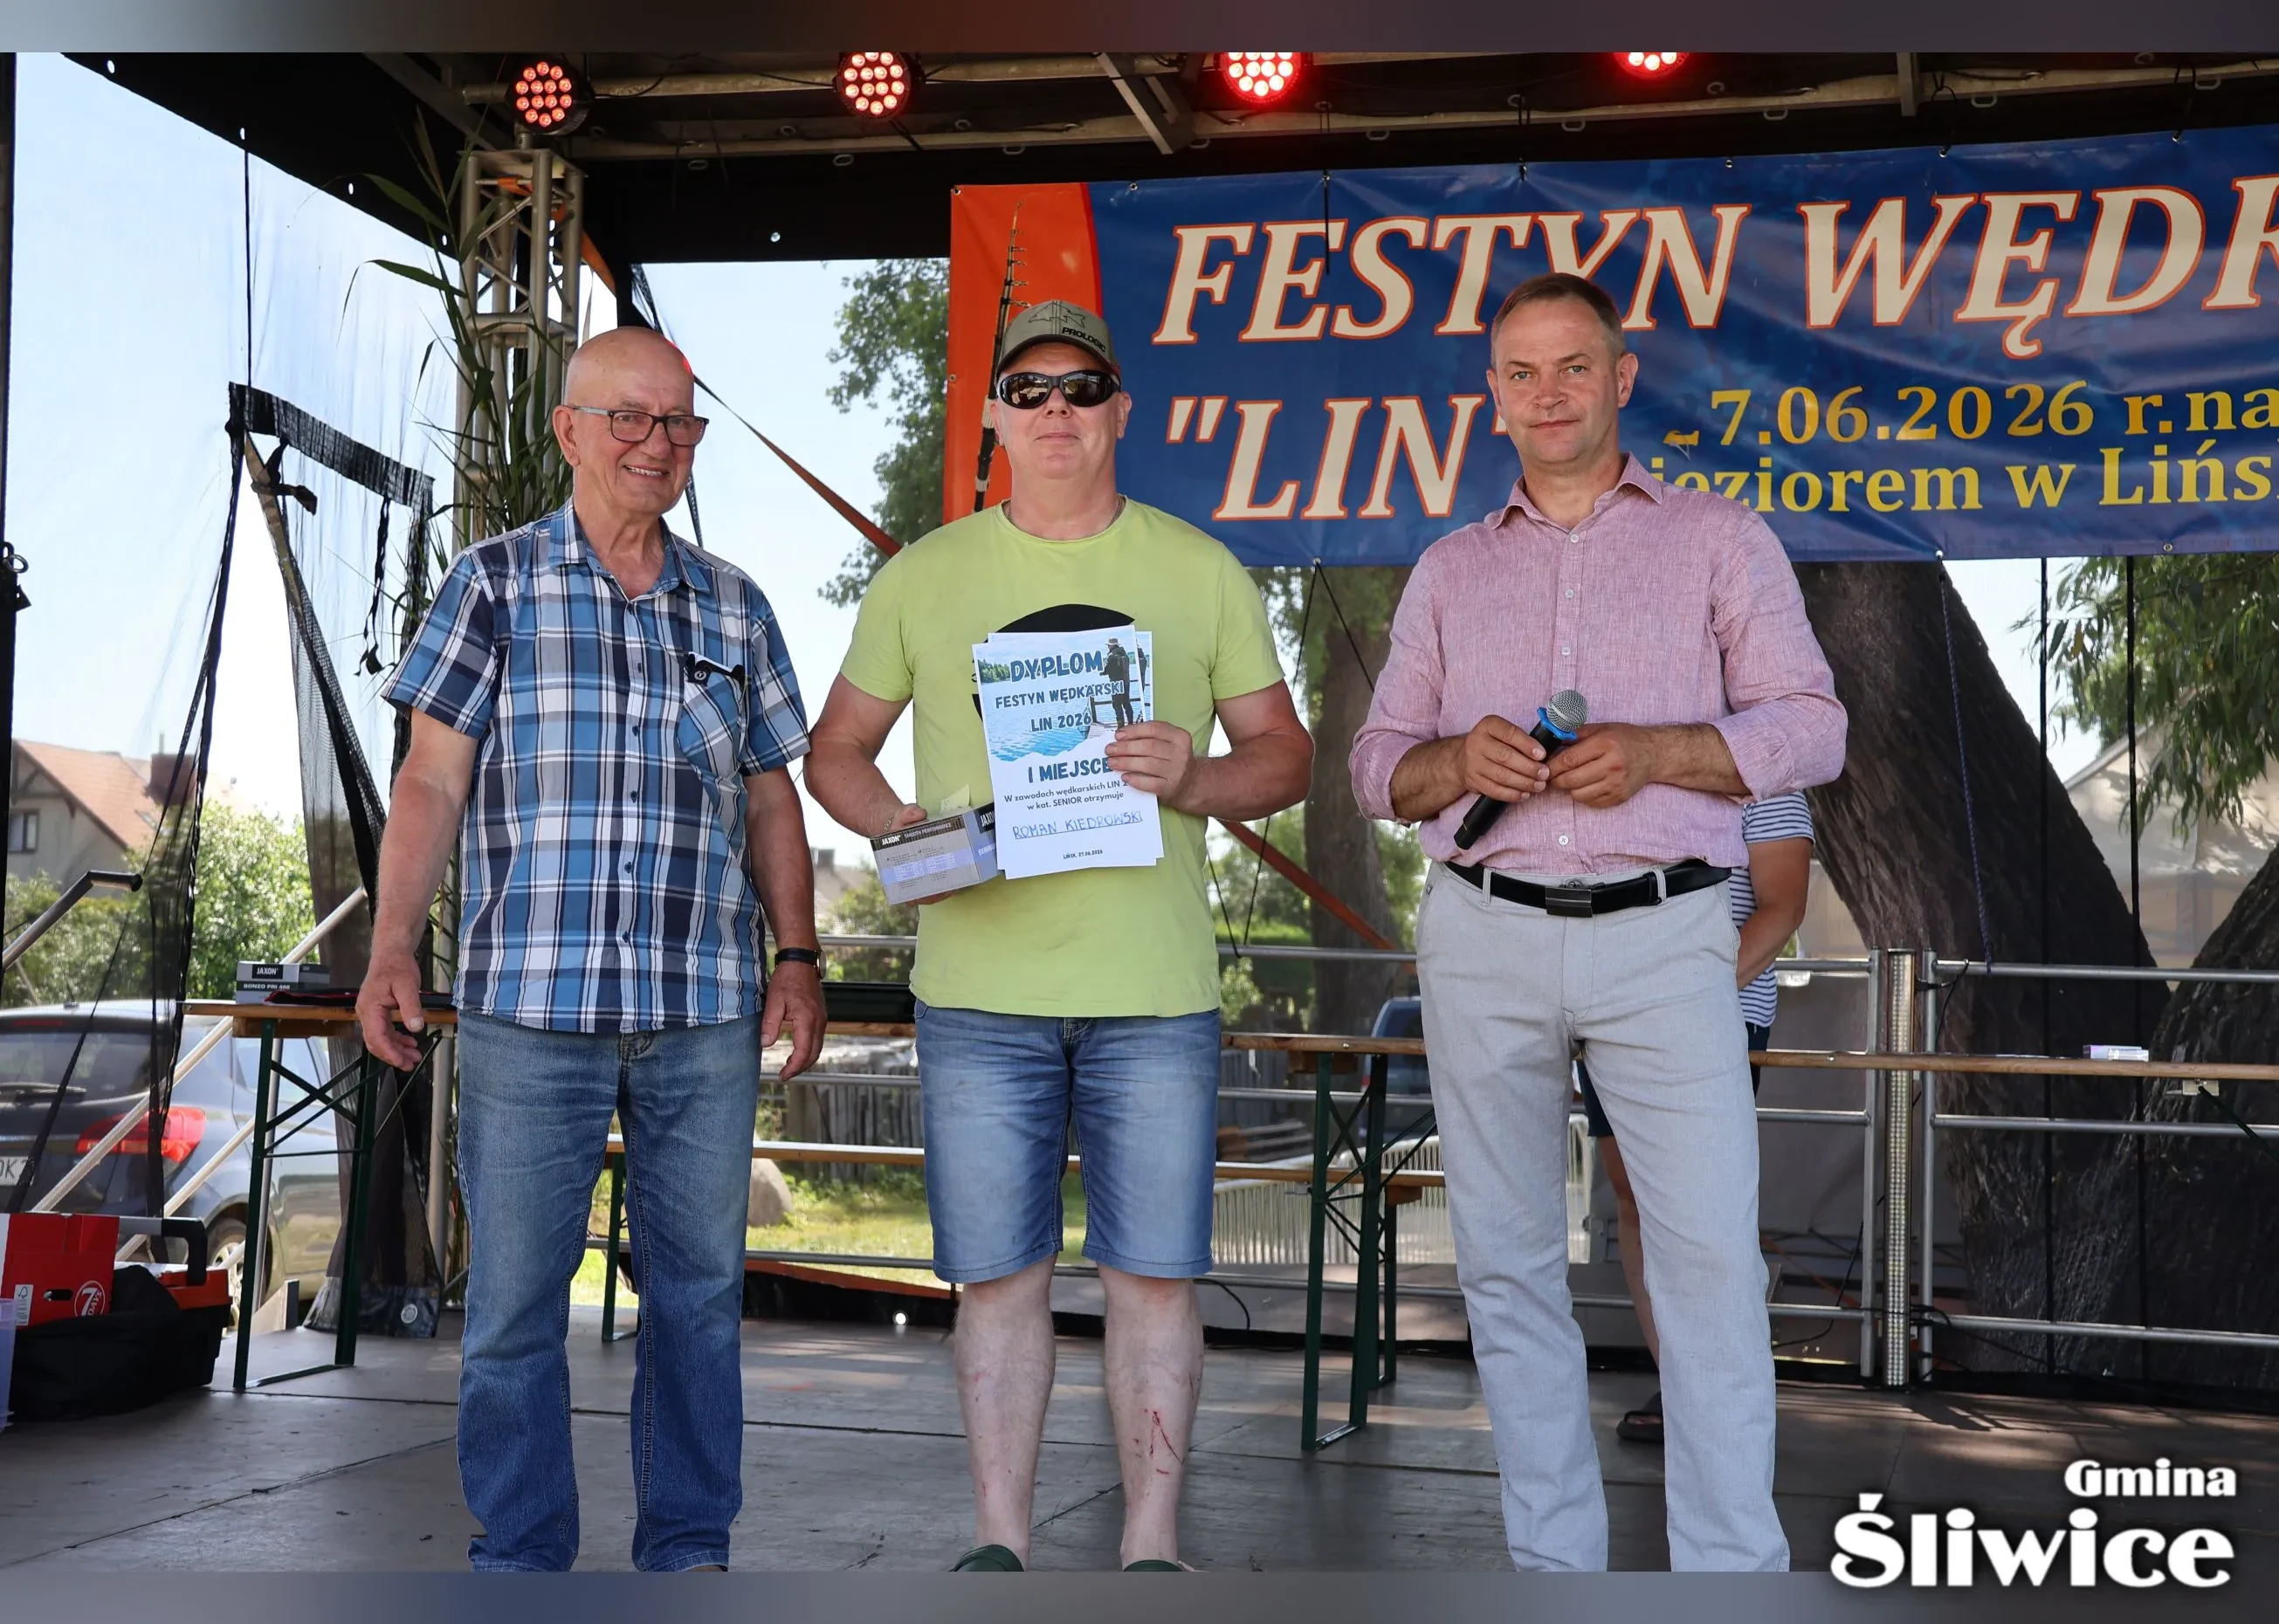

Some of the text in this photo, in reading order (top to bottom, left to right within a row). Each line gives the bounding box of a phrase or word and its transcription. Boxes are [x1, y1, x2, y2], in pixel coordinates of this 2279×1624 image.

[1152, 203, 1752, 346] FESTYN
[1062, 327, 1106, 353] PROLOGIC
[1166, 395, 1509, 521] "LIN
[2006, 464, 2076, 508] w
[2099, 439, 2279, 506] Lińs
[1010, 650, 1104, 683] DYPLOM
[995, 681, 1125, 709] FESTYN WĘDKARSKI
[1031, 712, 1092, 732] LIN 2026
[1028, 757, 1114, 783] I MIEJSCE
[1015, 789, 1055, 802] zawodach
[1056, 783, 1105, 797] wędkarskich
[1053, 796, 1082, 807] SENIOR
[1084, 792, 1124, 803] otrzymuje
[980, 811, 995, 828] JAXO
[882, 835, 901, 845] JAXON
[81, 1288, 98, 1317] 7
